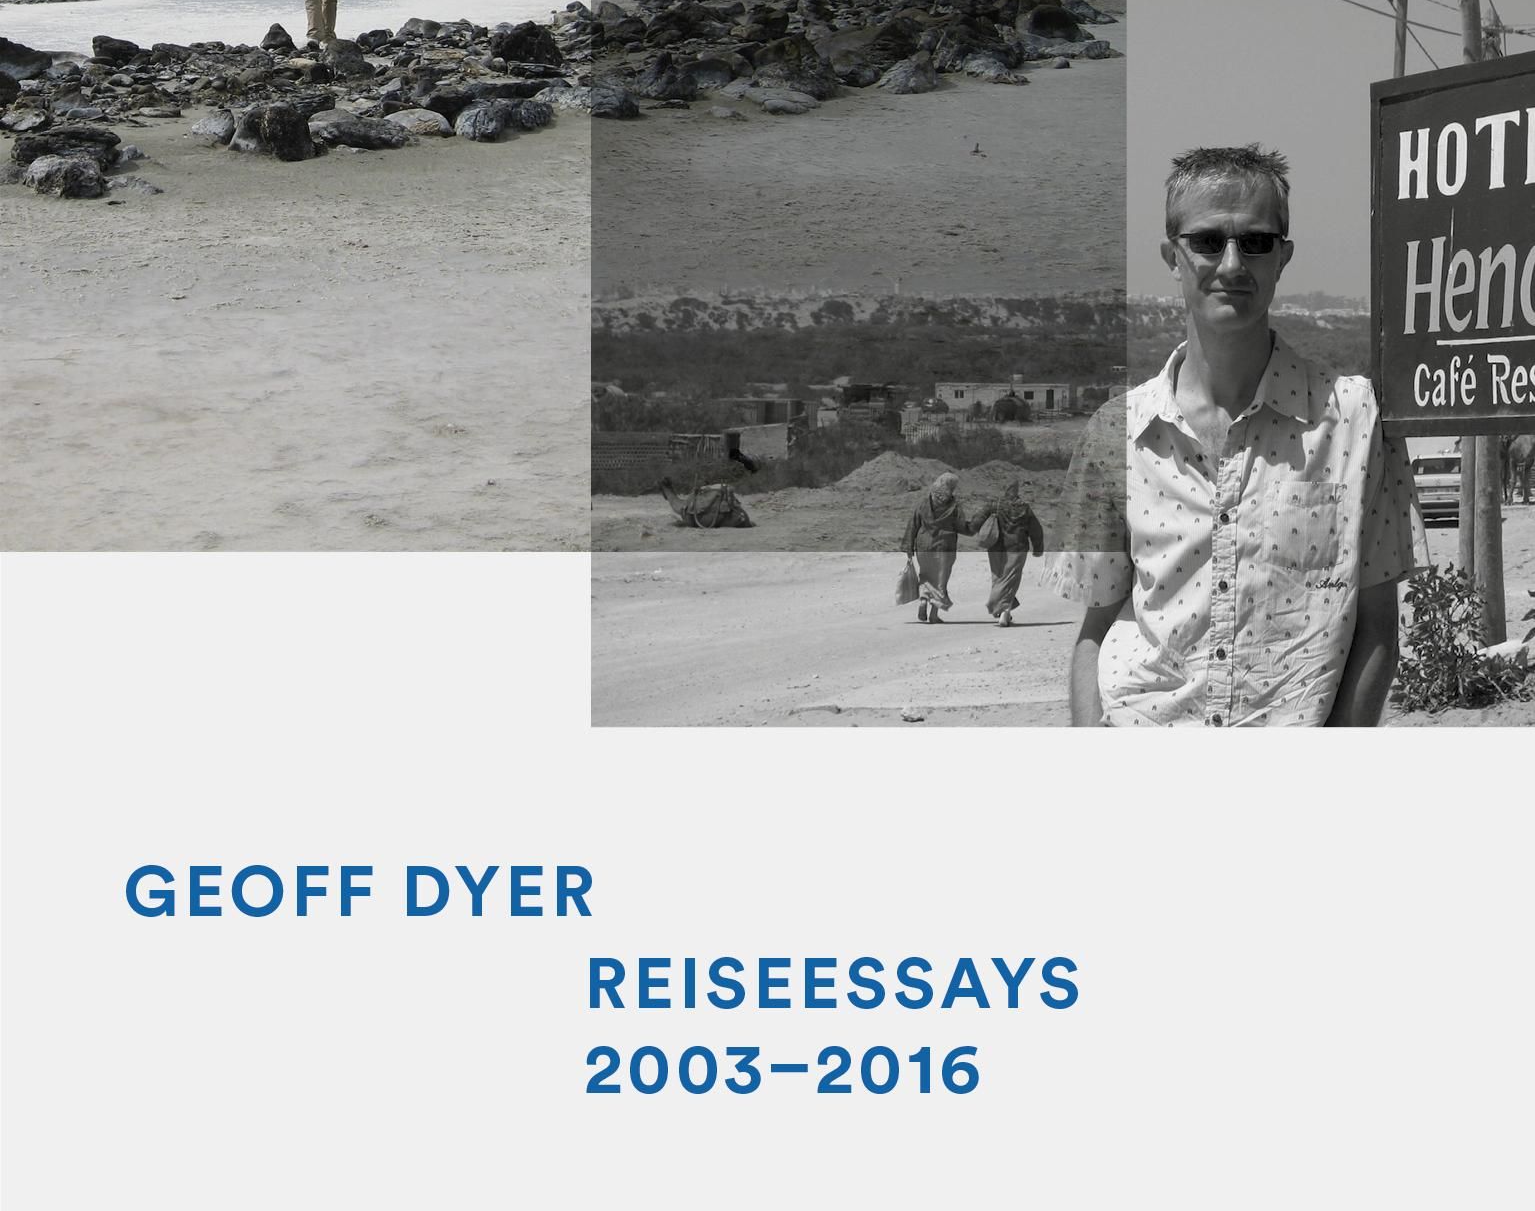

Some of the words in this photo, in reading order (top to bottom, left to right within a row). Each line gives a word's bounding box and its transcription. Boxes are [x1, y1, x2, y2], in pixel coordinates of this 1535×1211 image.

[1398, 108, 1535, 200] HOT
[1414, 355, 1477, 407] Café
[125, 864, 374, 918] GEOFF
[406, 865, 593, 917] DYER
[589, 956, 1079, 1010] REISEESSAYS
